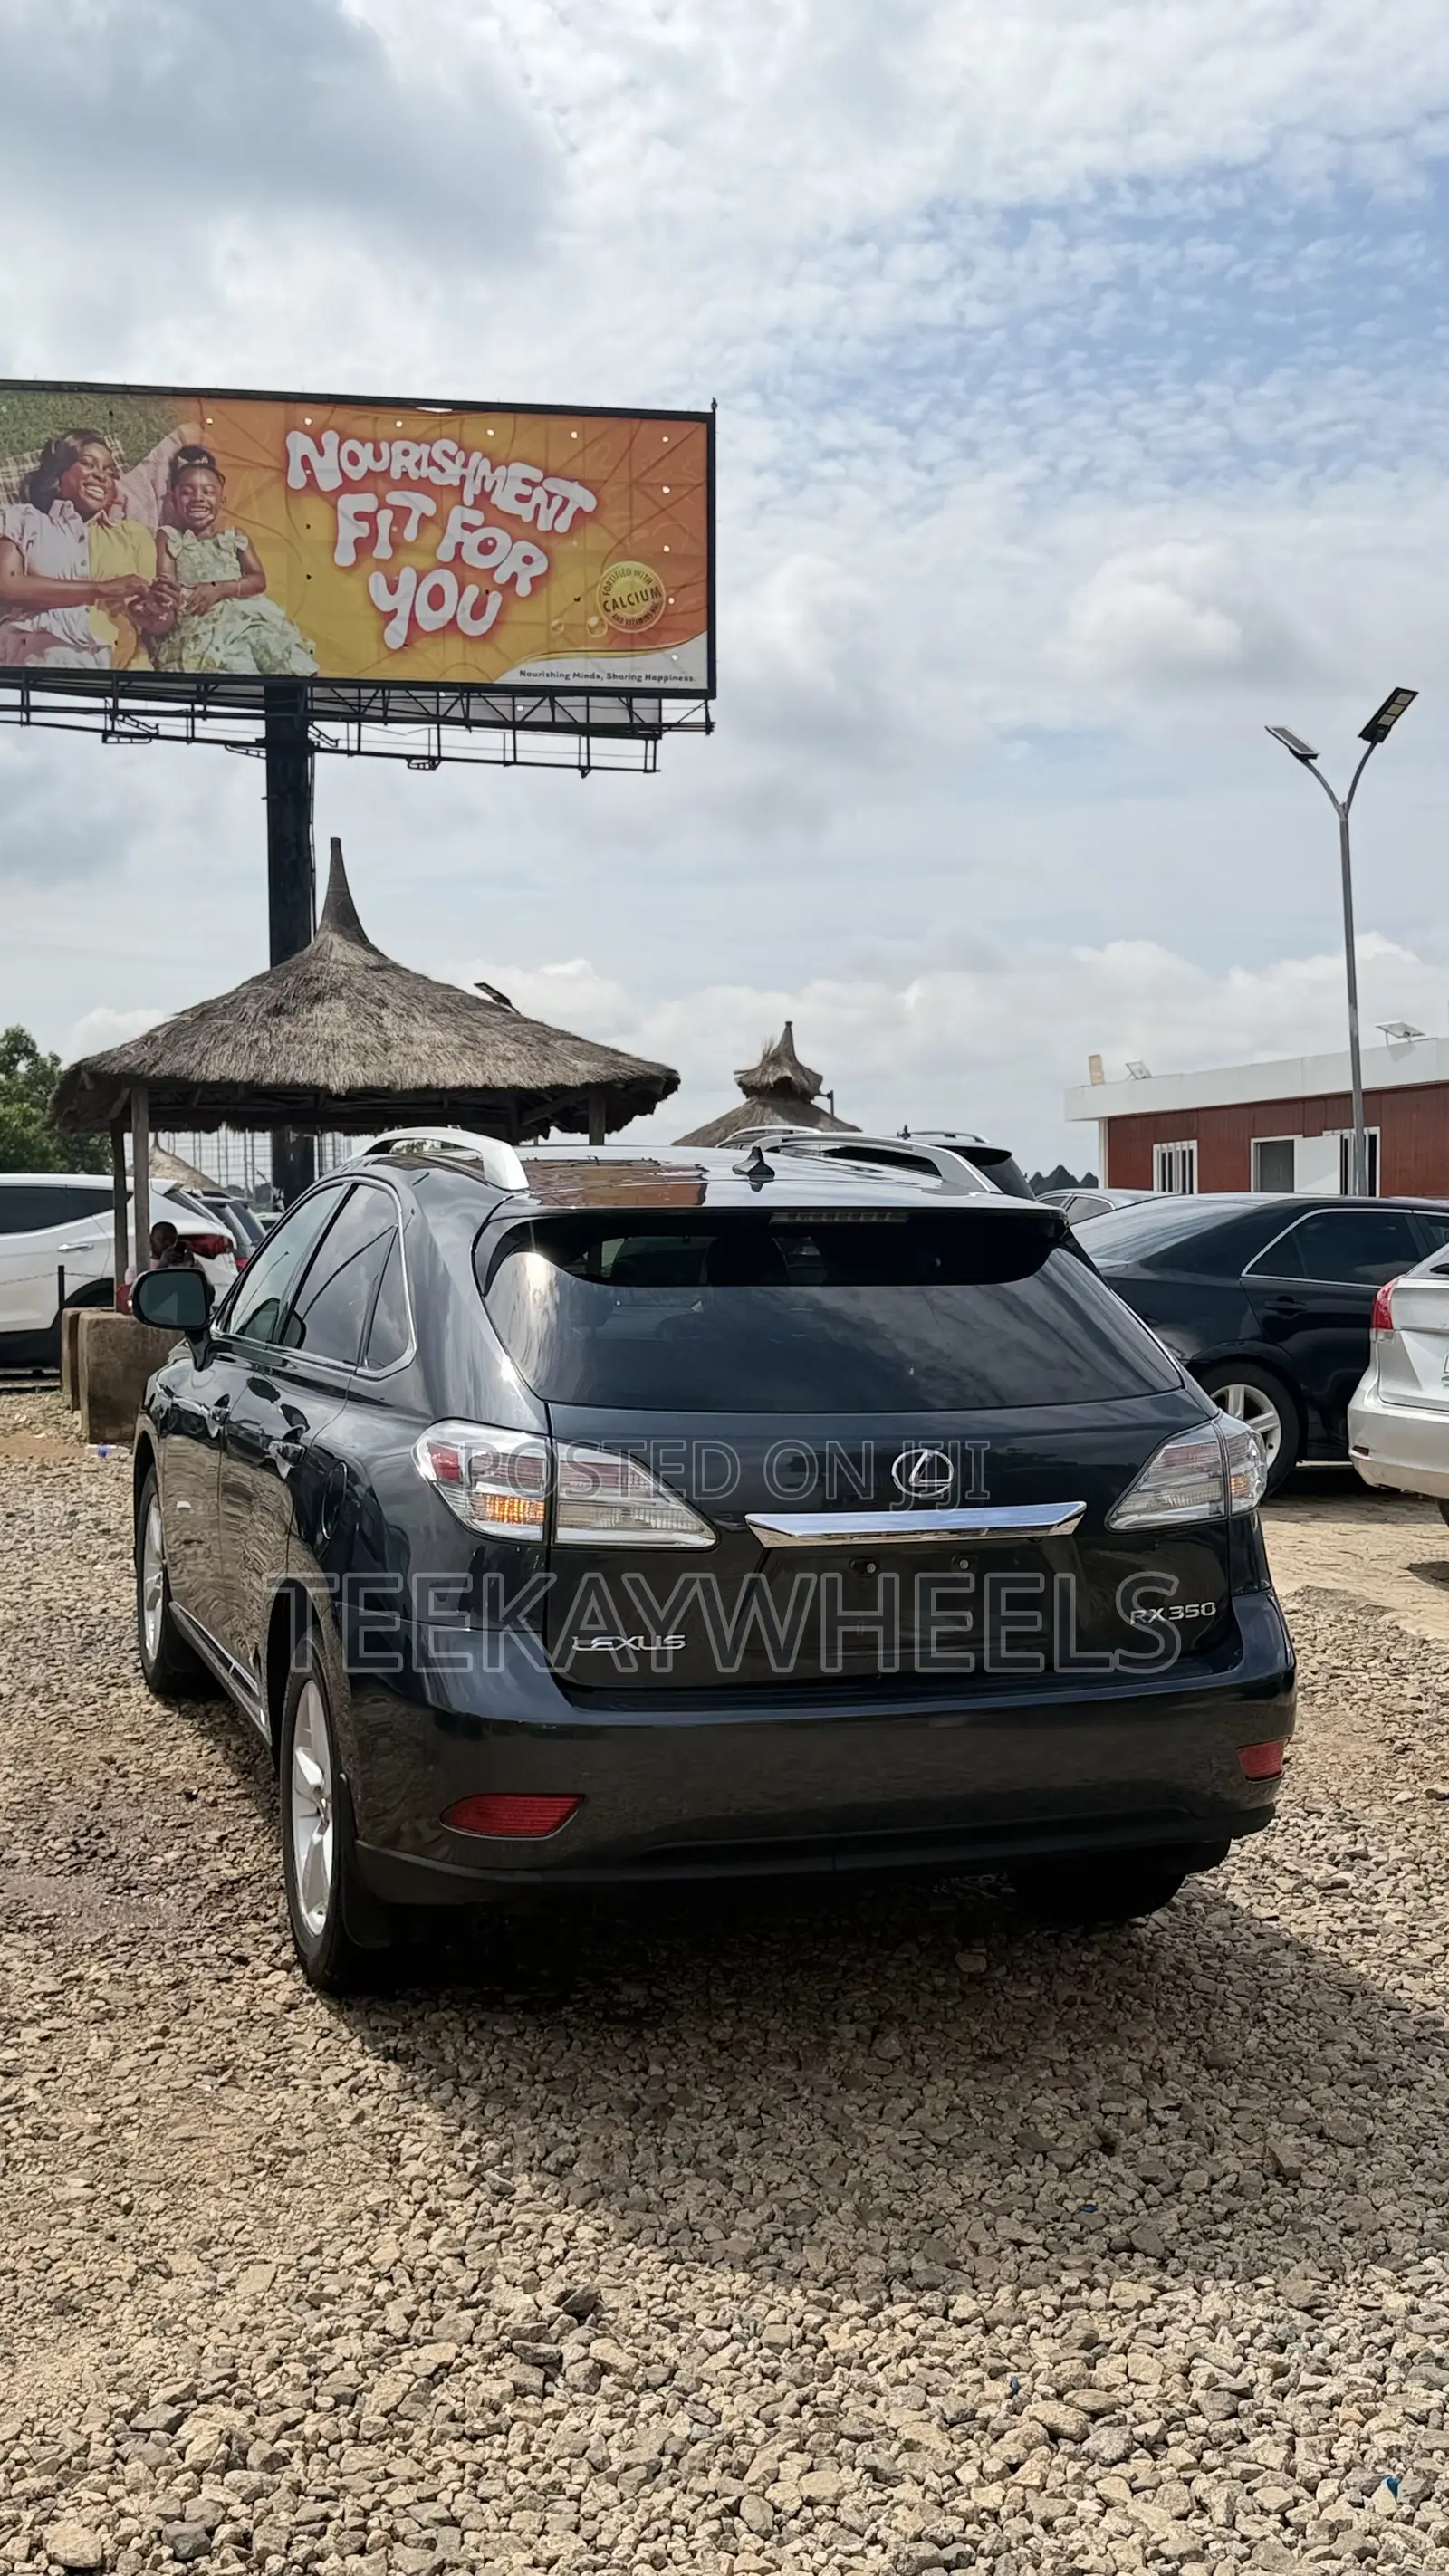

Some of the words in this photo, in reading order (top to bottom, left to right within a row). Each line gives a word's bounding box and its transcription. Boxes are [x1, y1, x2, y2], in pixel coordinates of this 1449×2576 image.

[285, 430, 598, 533] NOURISHMENT
[333, 490, 437, 567] FIT
[437, 505, 549, 598] FOR
[368, 566, 503, 650] YOU
[602, 585, 662, 613] CALCIUM
[519, 669, 571, 682] Nourishing
[572, 671, 604, 682] Minds,
[606, 672, 643, 683] Sharing
[571, 1634, 686, 1652] LEXUS
